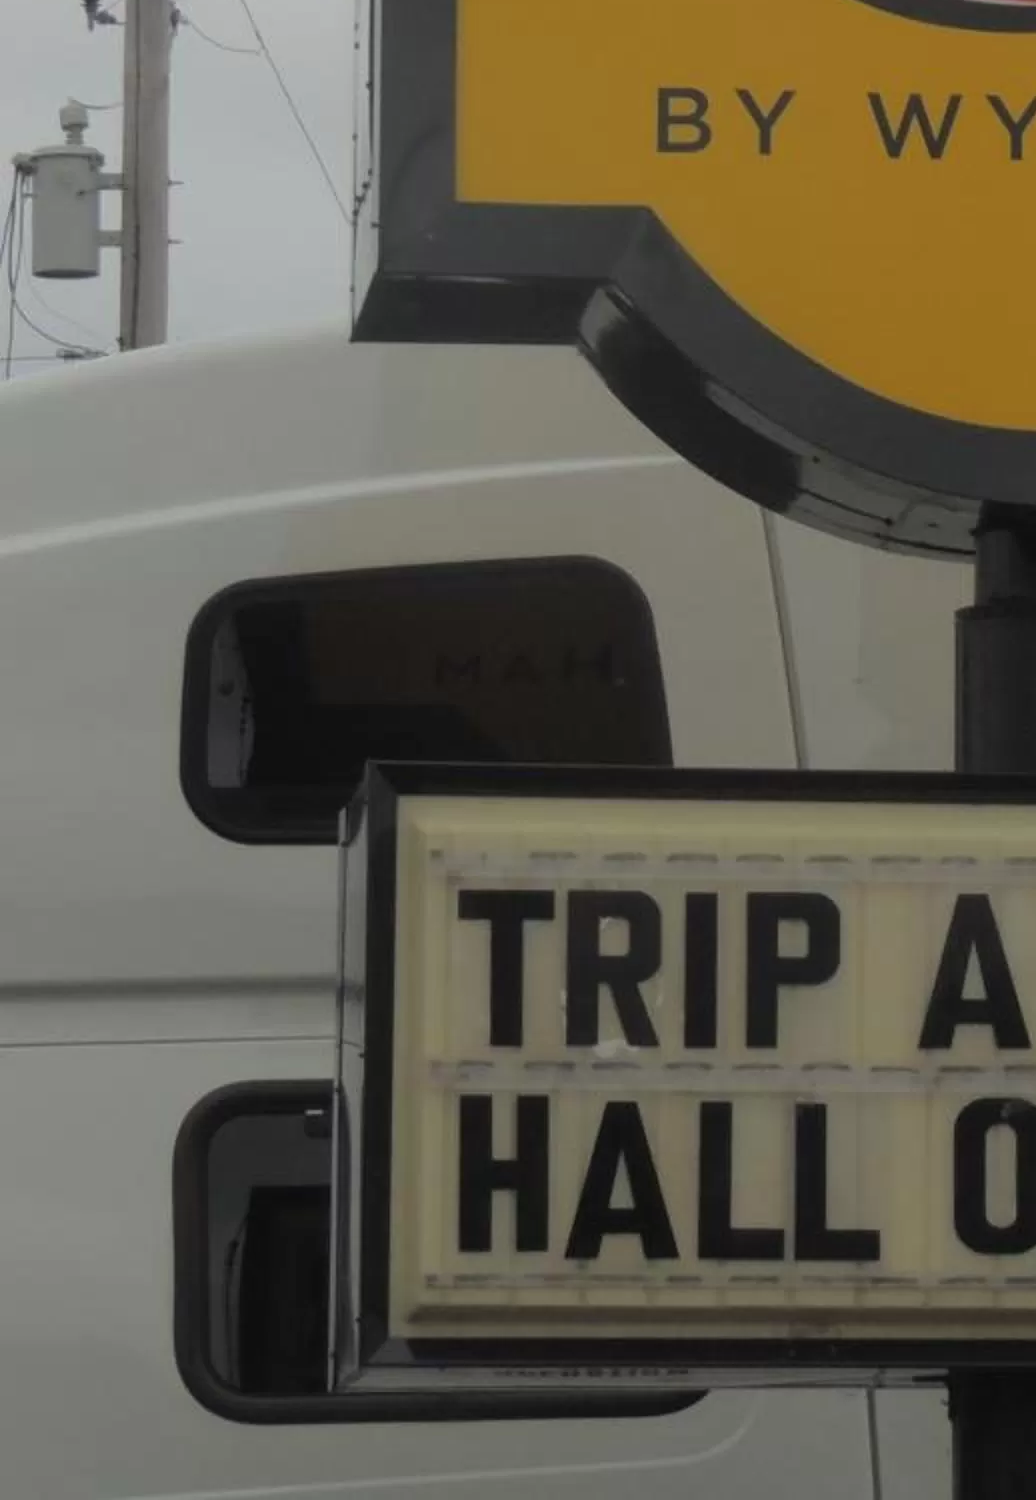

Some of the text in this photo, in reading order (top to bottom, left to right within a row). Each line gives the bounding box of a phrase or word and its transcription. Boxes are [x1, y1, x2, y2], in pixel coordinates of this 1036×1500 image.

[655, 86, 798, 157] BY
[457, 888, 842, 1050] TRIP
[457, 1095, 881, 1262] HALL
